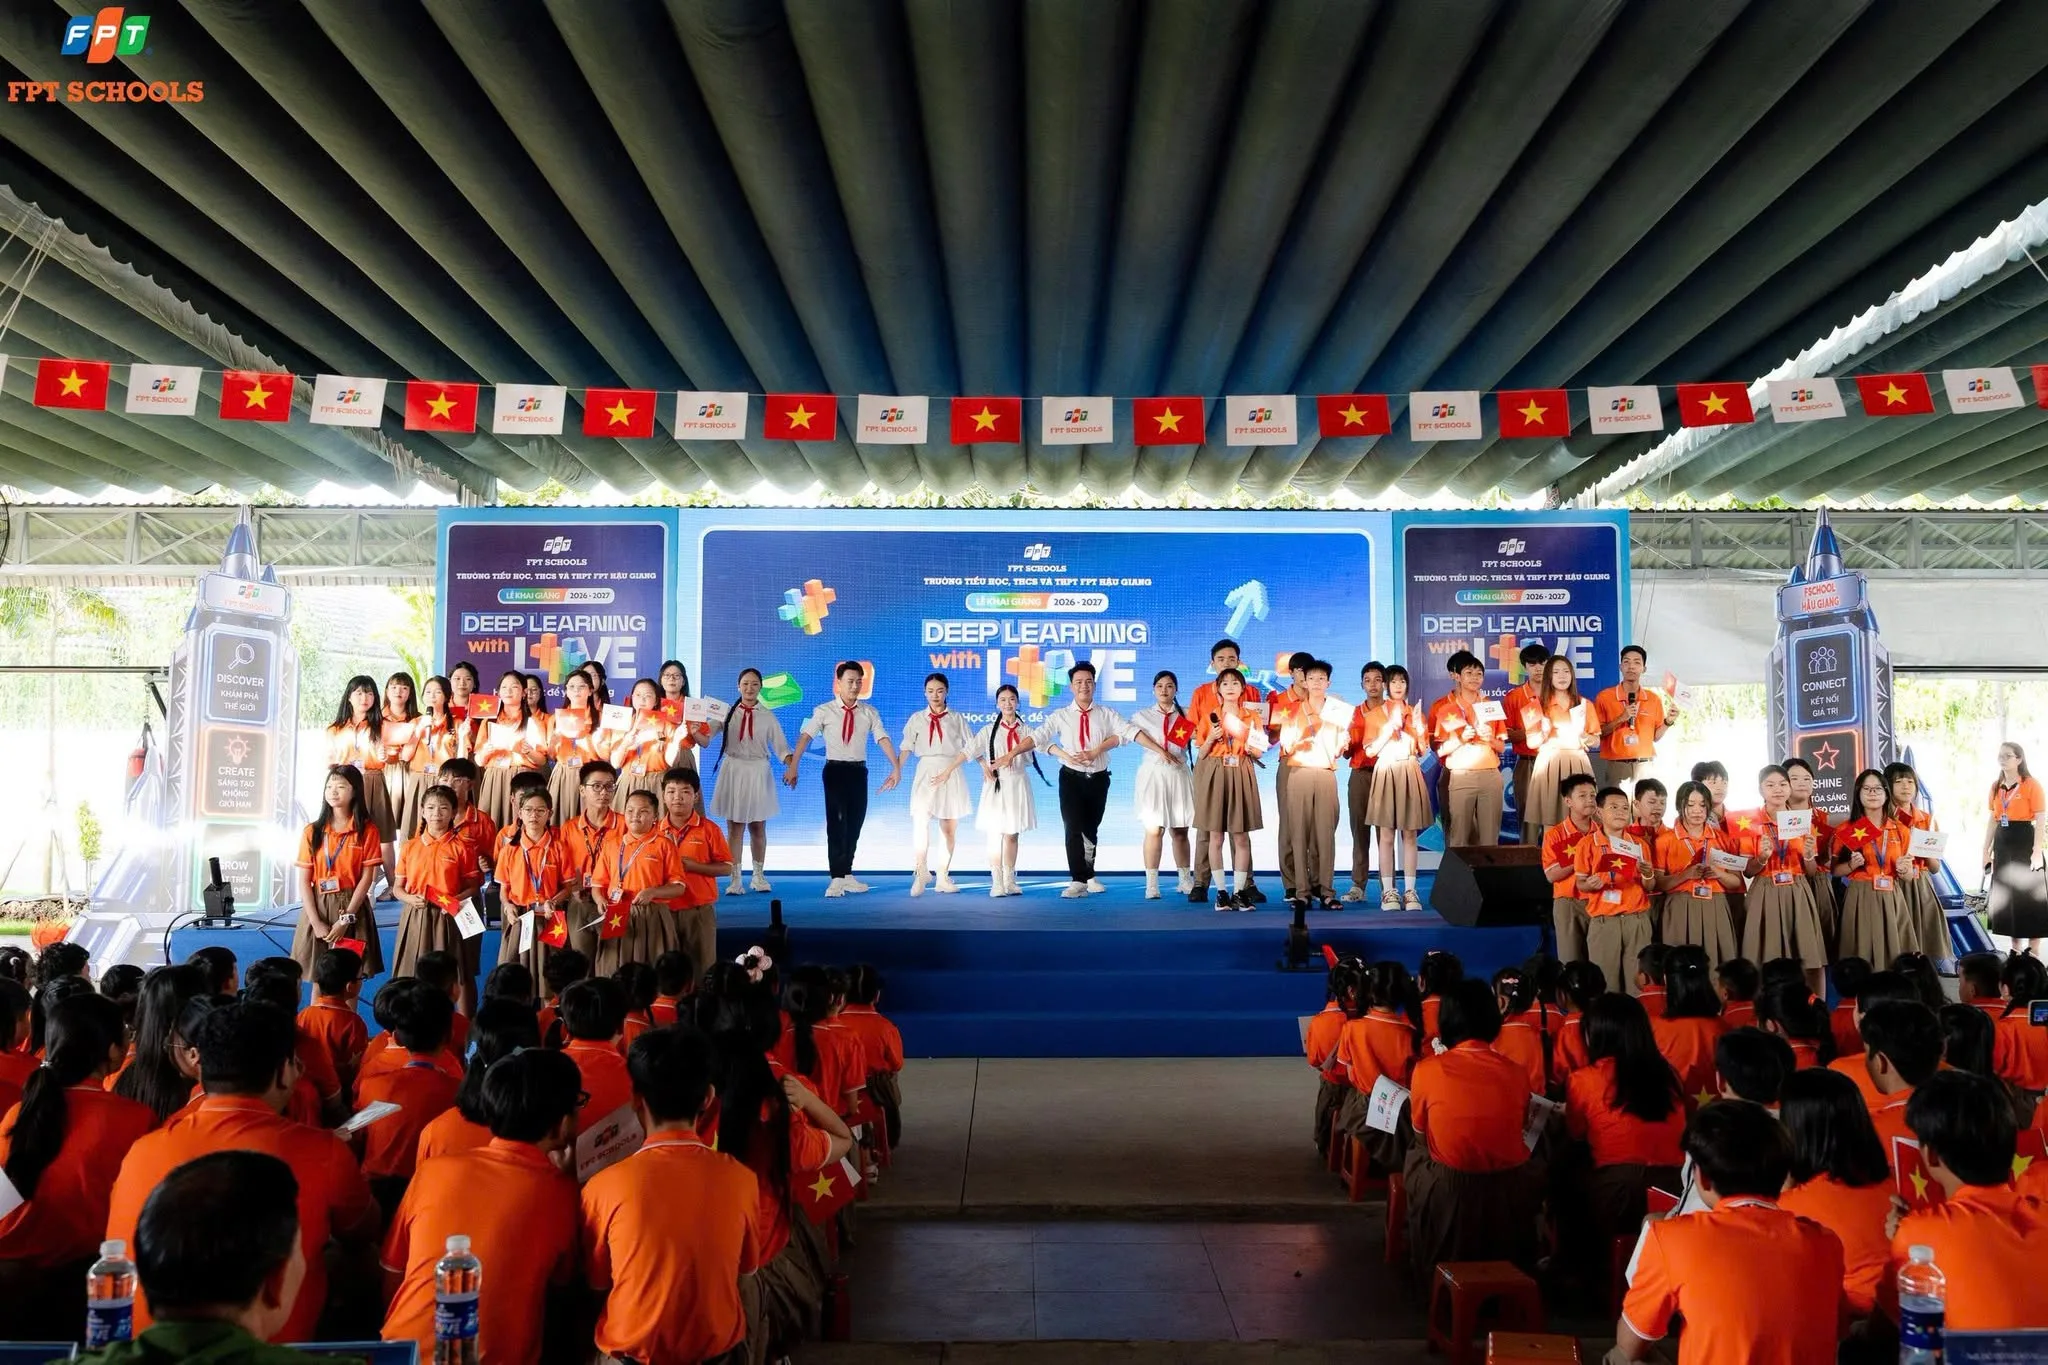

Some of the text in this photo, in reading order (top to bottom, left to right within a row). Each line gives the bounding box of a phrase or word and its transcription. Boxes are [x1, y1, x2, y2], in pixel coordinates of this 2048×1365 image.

[544, 558, 587, 566] SCHOOLS
[1804, 583, 1836, 597] FSCHOOL
[1054, 598, 1075, 606] 2026
[1082, 598, 1102, 606] 2027
[1802, 597, 1839, 612] HẬU GIANG
[464, 615, 646, 632] DEEP LEARNING
[1424, 616, 1601, 633] DEEP LEARNING
[926, 623, 1147, 643] DEEP LEARNING
[468, 638, 509, 653] with
[1428, 640, 1469, 654] with
[930, 650, 980, 668] with
[217, 673, 264, 687] DISCOVER
[1802, 678, 1847, 692] CONNECT
[221, 690, 259, 700] KHÁM PHÁ
[1810, 695, 1839, 706] KẾT NỐI
[1813, 709, 1825, 717] GIÁ
[218, 767, 255, 777] CREATE
[1813, 778, 1842, 789] SHINE
[1827, 792, 1847, 801] SÁNG
[1829, 804, 1850, 813] CÁCH
